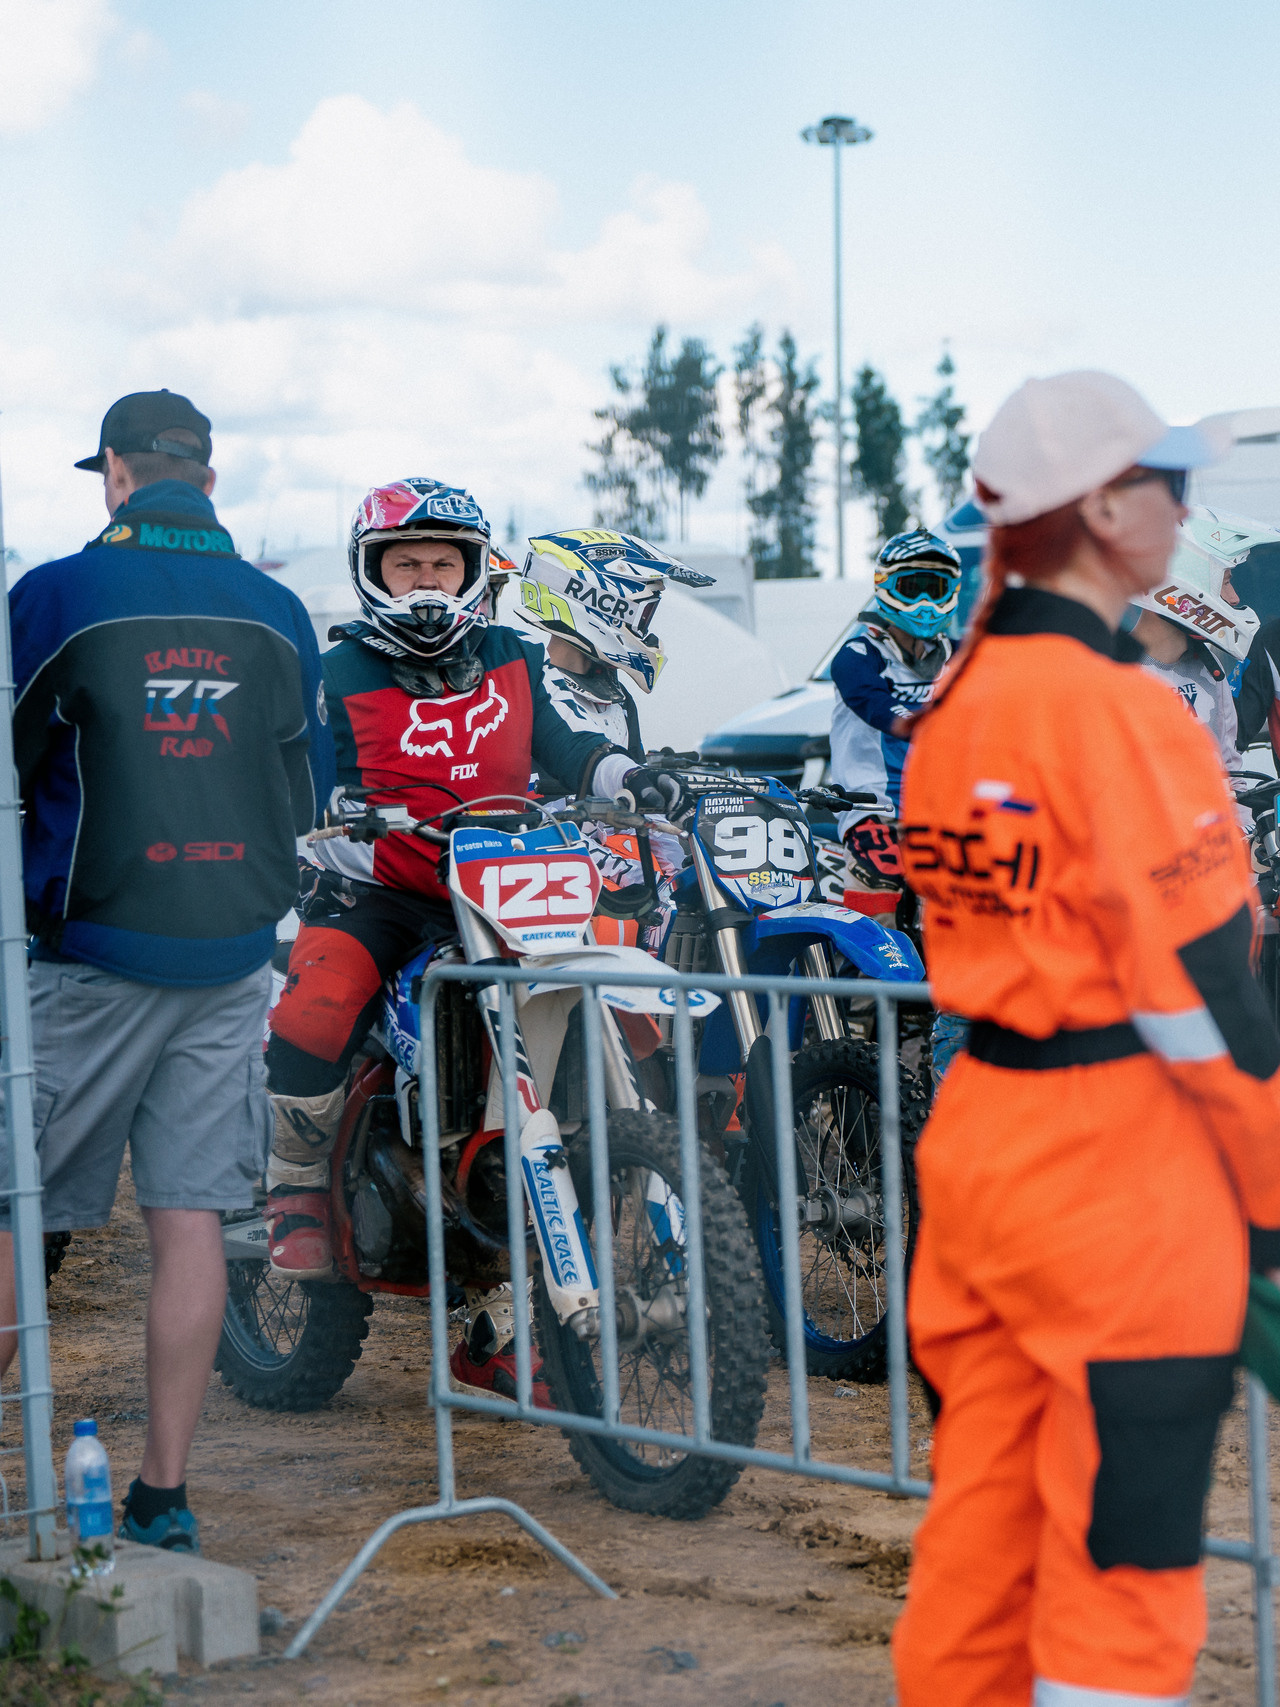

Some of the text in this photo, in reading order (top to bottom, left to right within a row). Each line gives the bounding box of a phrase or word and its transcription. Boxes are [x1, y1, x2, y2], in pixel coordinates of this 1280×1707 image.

[144, 648, 232, 676] BALTIC
[450, 763, 479, 781] FOX
[705, 797, 743, 806] ПЛУГИН
[705, 805, 744, 815] КИРИЛЛ
[714, 816, 810, 872] 98
[479, 862, 593, 921] 123
[552, 1232, 581, 1286] RACE
